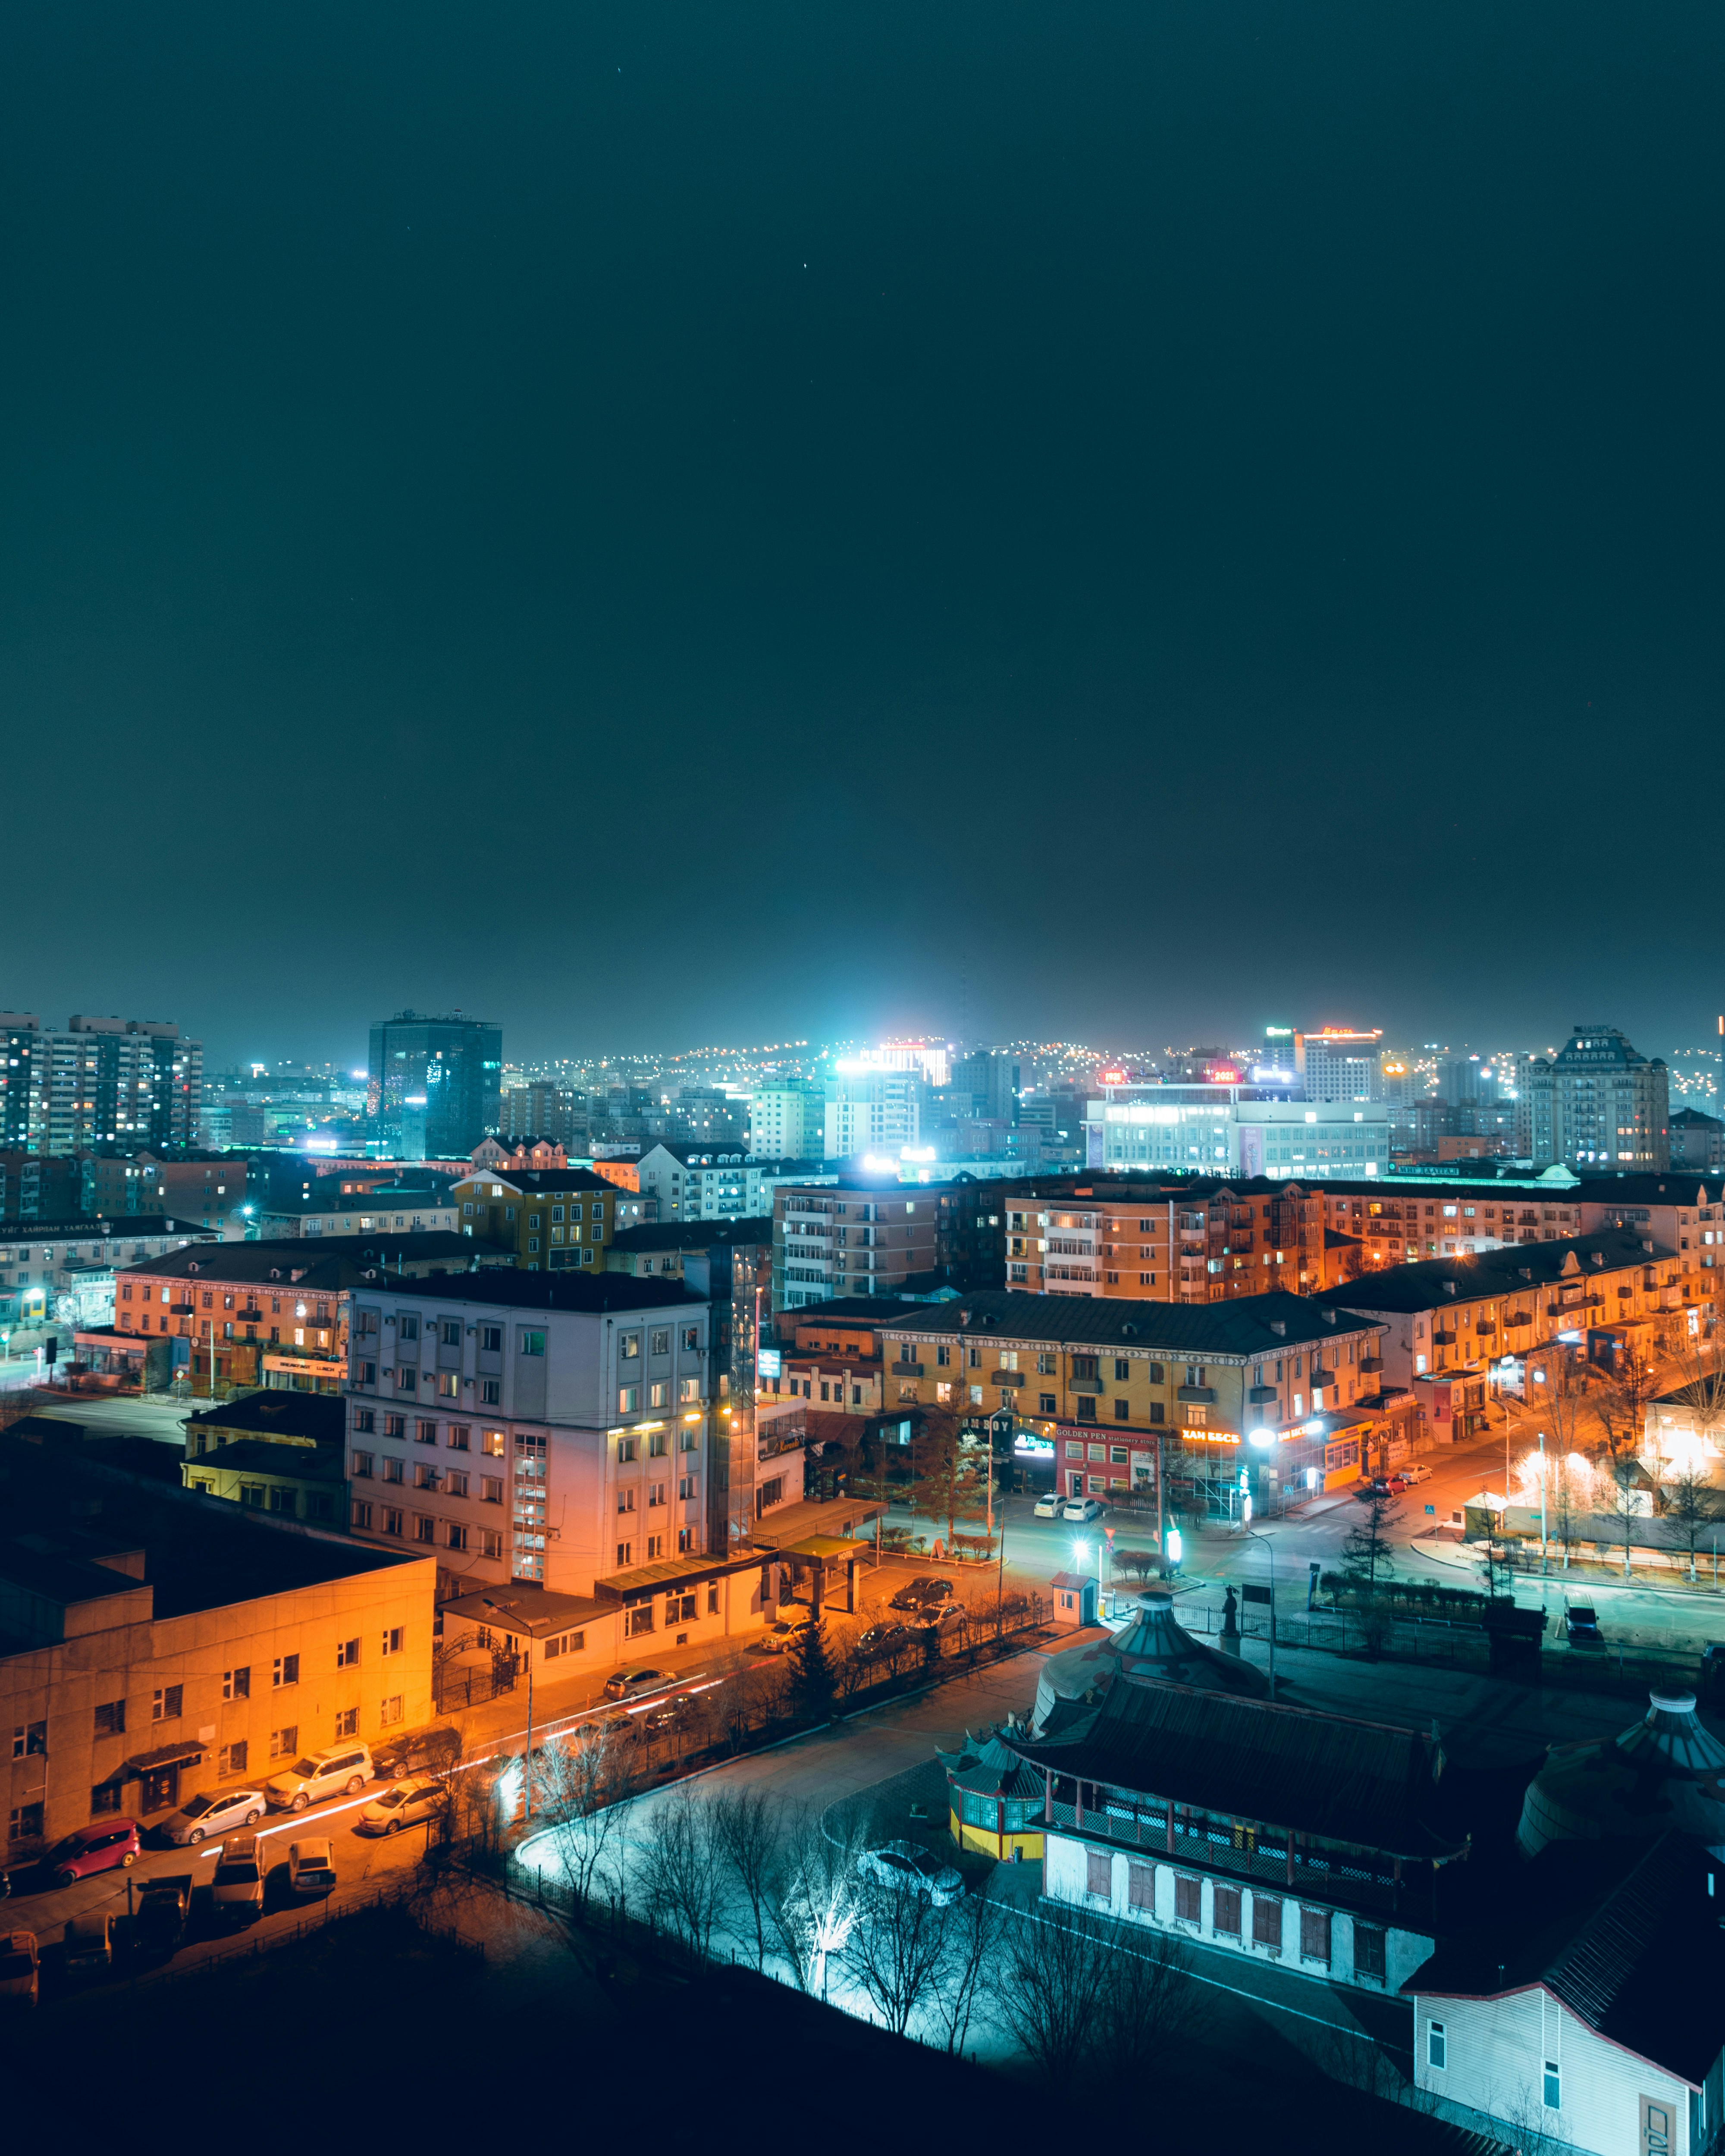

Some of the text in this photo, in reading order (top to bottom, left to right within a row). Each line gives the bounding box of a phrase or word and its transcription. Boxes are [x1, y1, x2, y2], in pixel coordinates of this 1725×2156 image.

[1105, 1072, 1122, 1082] 1921
[1214, 1071, 1234, 1081] 2021
[1057, 1429, 1088, 1438] GOLDEN
[1182, 1429, 1240, 1444] ХАН ББСБ
[838, 1550, 853, 1561] HOTEL
